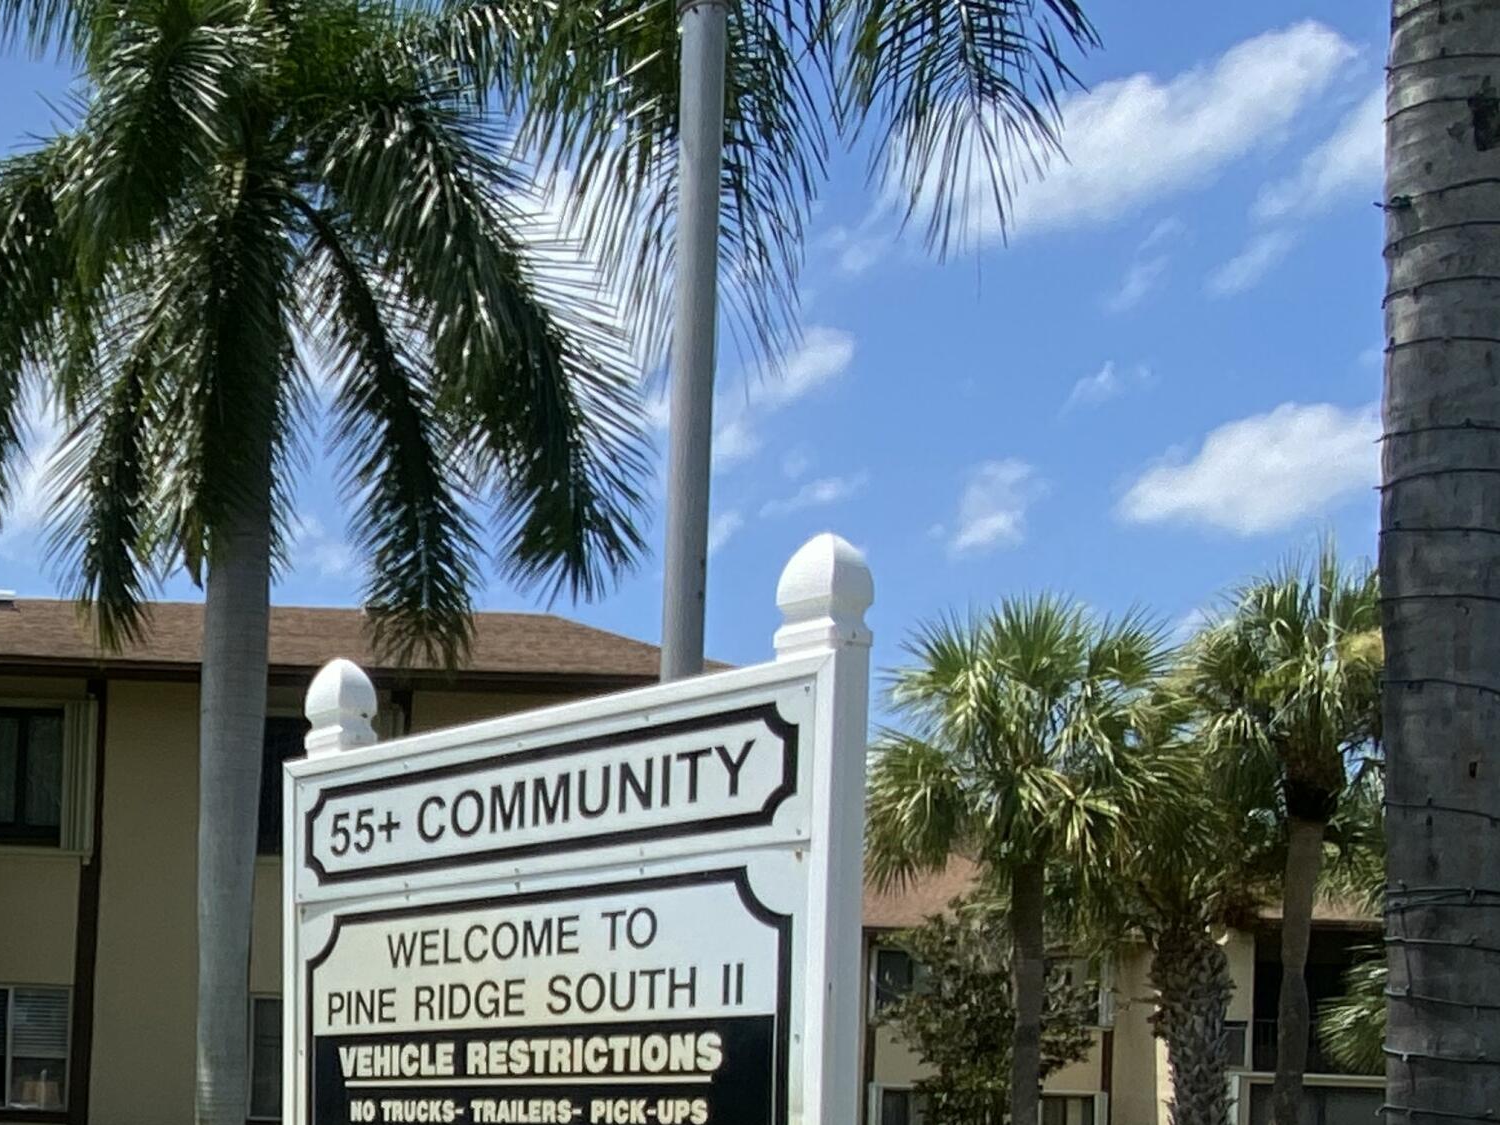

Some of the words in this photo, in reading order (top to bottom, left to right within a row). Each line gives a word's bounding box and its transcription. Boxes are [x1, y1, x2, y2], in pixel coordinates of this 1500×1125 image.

[330, 807, 400, 857] 55+
[417, 739, 757, 844] COMMUNITY
[387, 915, 581, 968] WELCOME
[601, 907, 658, 951] TO
[327, 987, 397, 1026] PINE
[414, 979, 526, 1021] RIDGE
[547, 967, 697, 1015] SOUTH
[722, 962, 745, 1006] II
[338, 1042, 455, 1079] VEHICLE
[466, 1032, 723, 1077] RESTRICTIONS
[350, 1100, 375, 1122] NO
[590, 1098, 708, 1125] PICK-UPS
